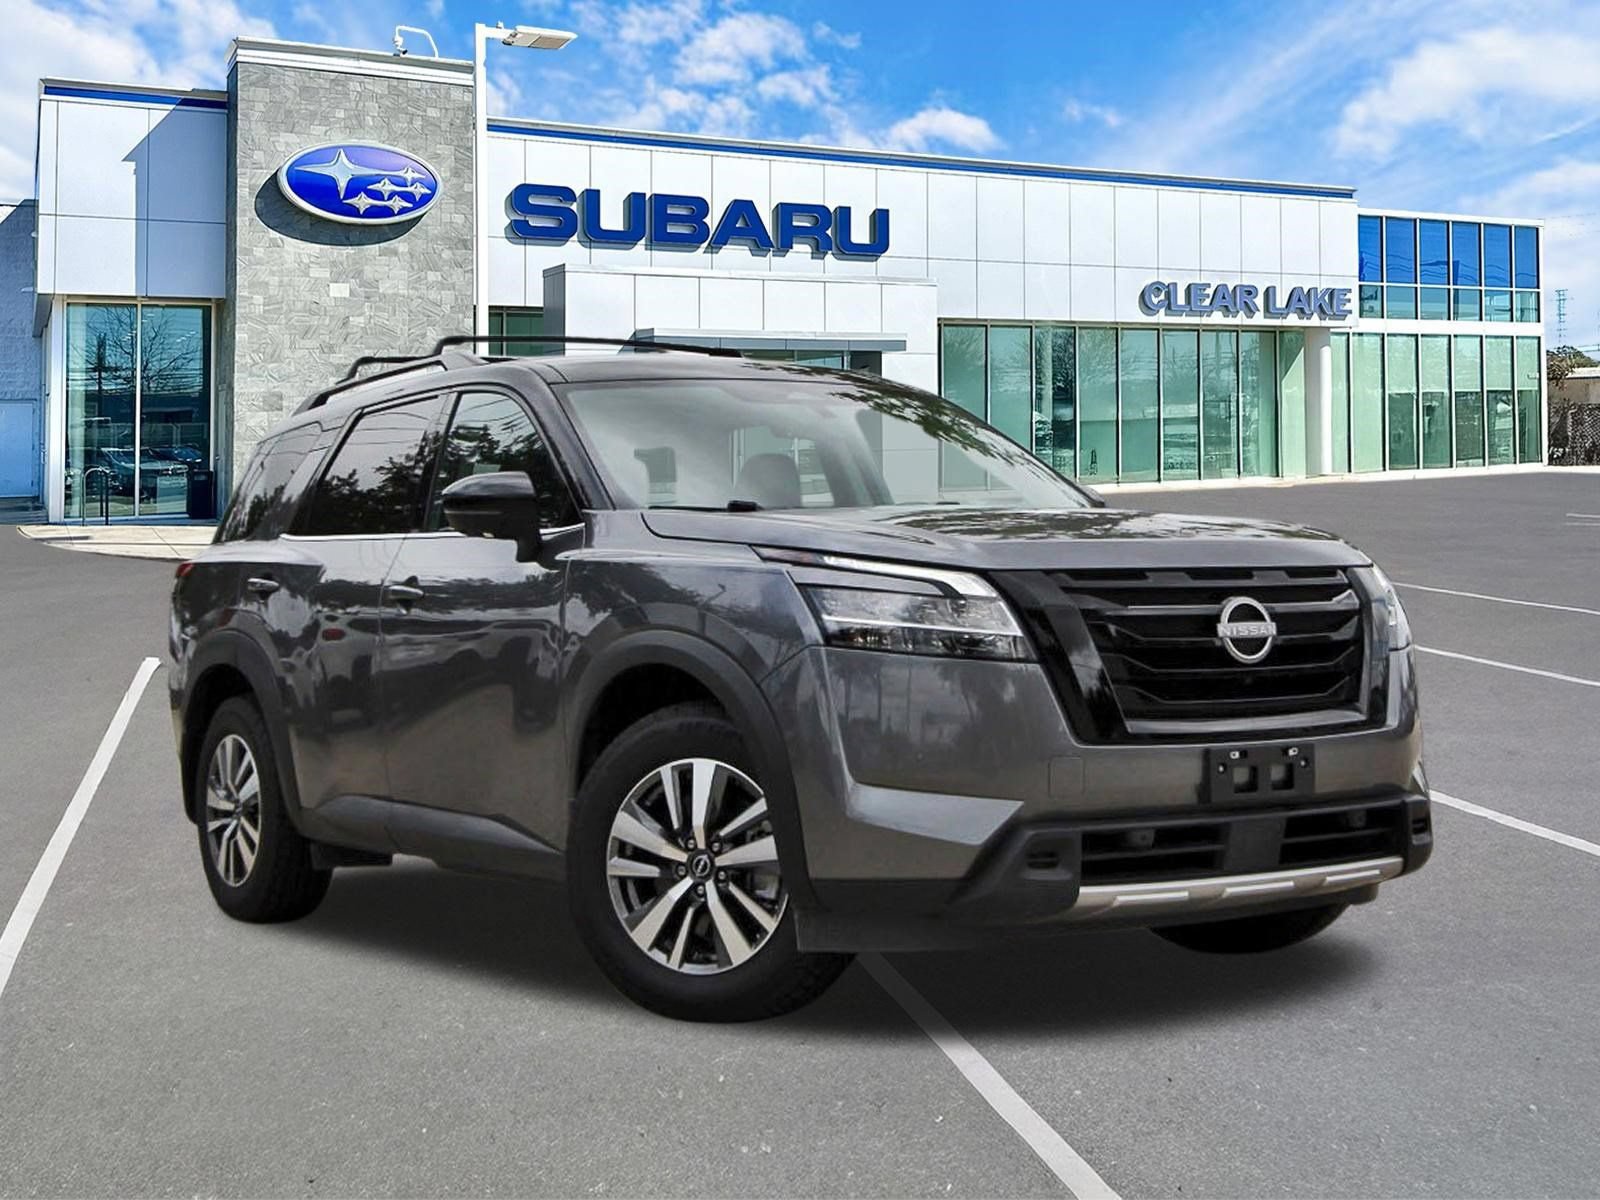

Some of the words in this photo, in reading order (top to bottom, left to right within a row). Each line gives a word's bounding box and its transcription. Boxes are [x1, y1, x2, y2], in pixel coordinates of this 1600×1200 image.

[505, 182, 890, 259] SUBARU
[1140, 280, 1261, 318] CLEAR
[1263, 285, 1353, 320] LAKE
[1219, 624, 1276, 637] NISSAN
